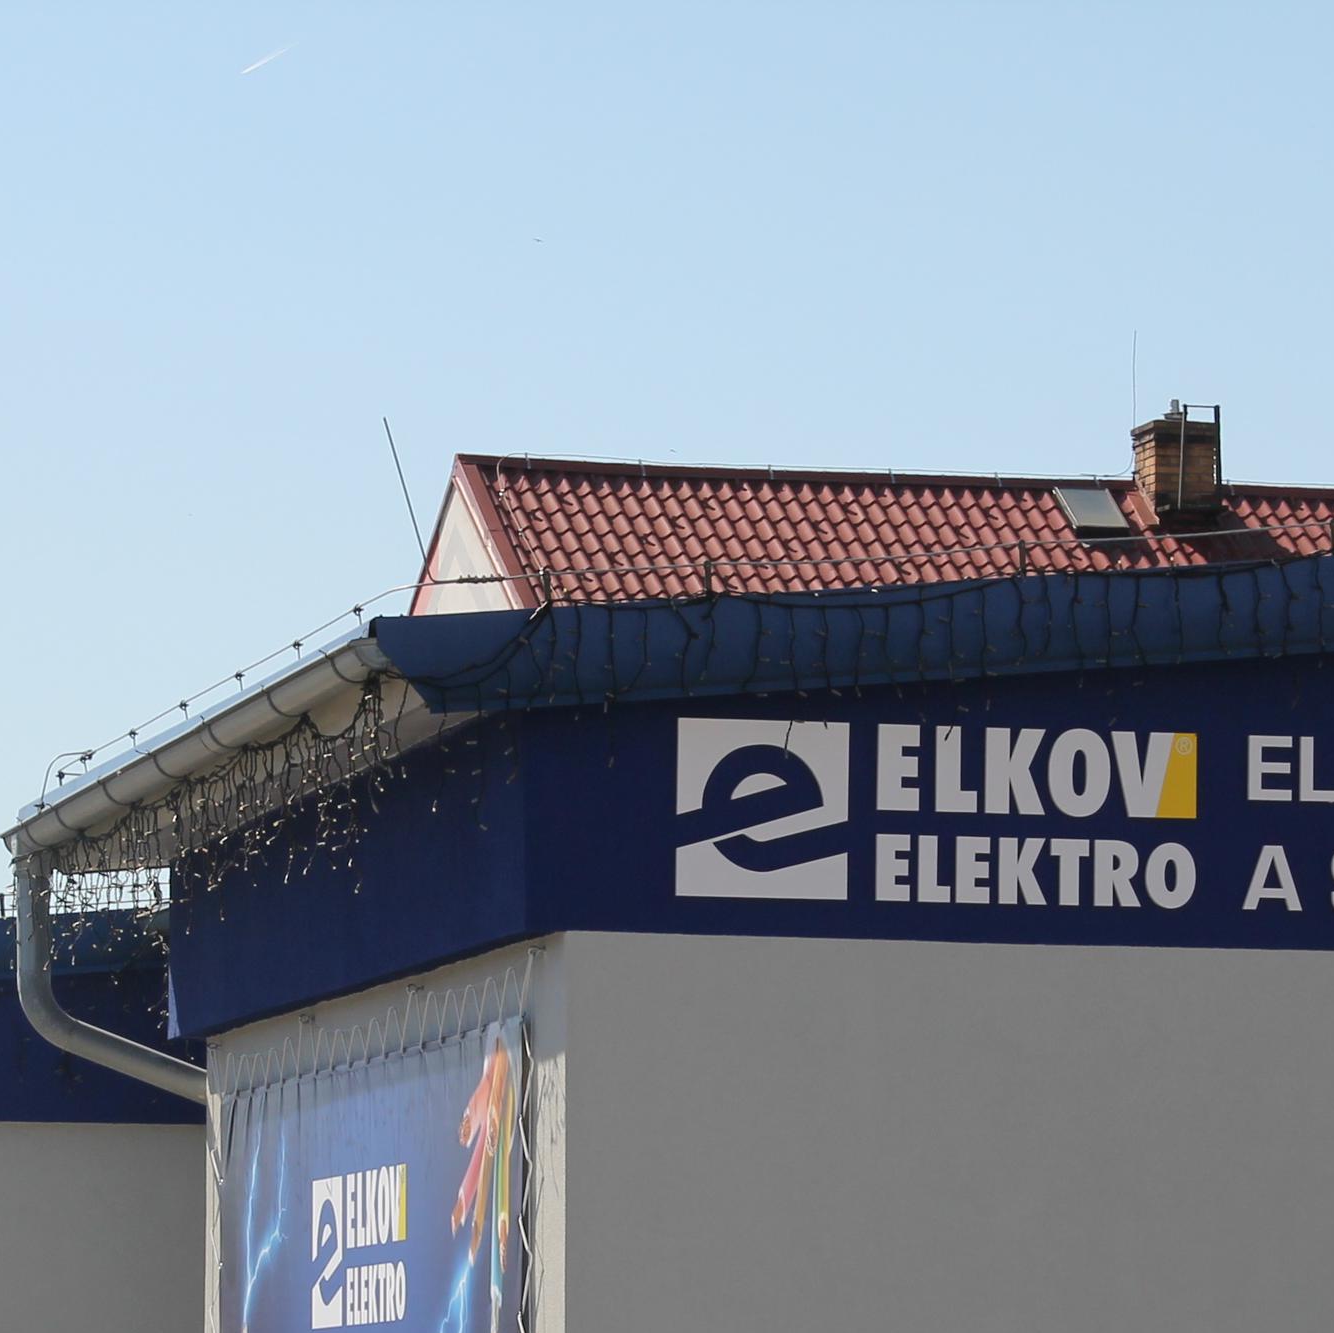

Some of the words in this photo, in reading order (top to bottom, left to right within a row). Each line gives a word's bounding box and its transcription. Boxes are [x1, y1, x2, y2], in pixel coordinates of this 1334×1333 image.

[876, 833, 1197, 910] ELEKTRO
[1242, 845, 1303, 912] A
[346, 1163, 403, 1249] ELKOV
[346, 1260, 406, 1327] ELEKTRO
